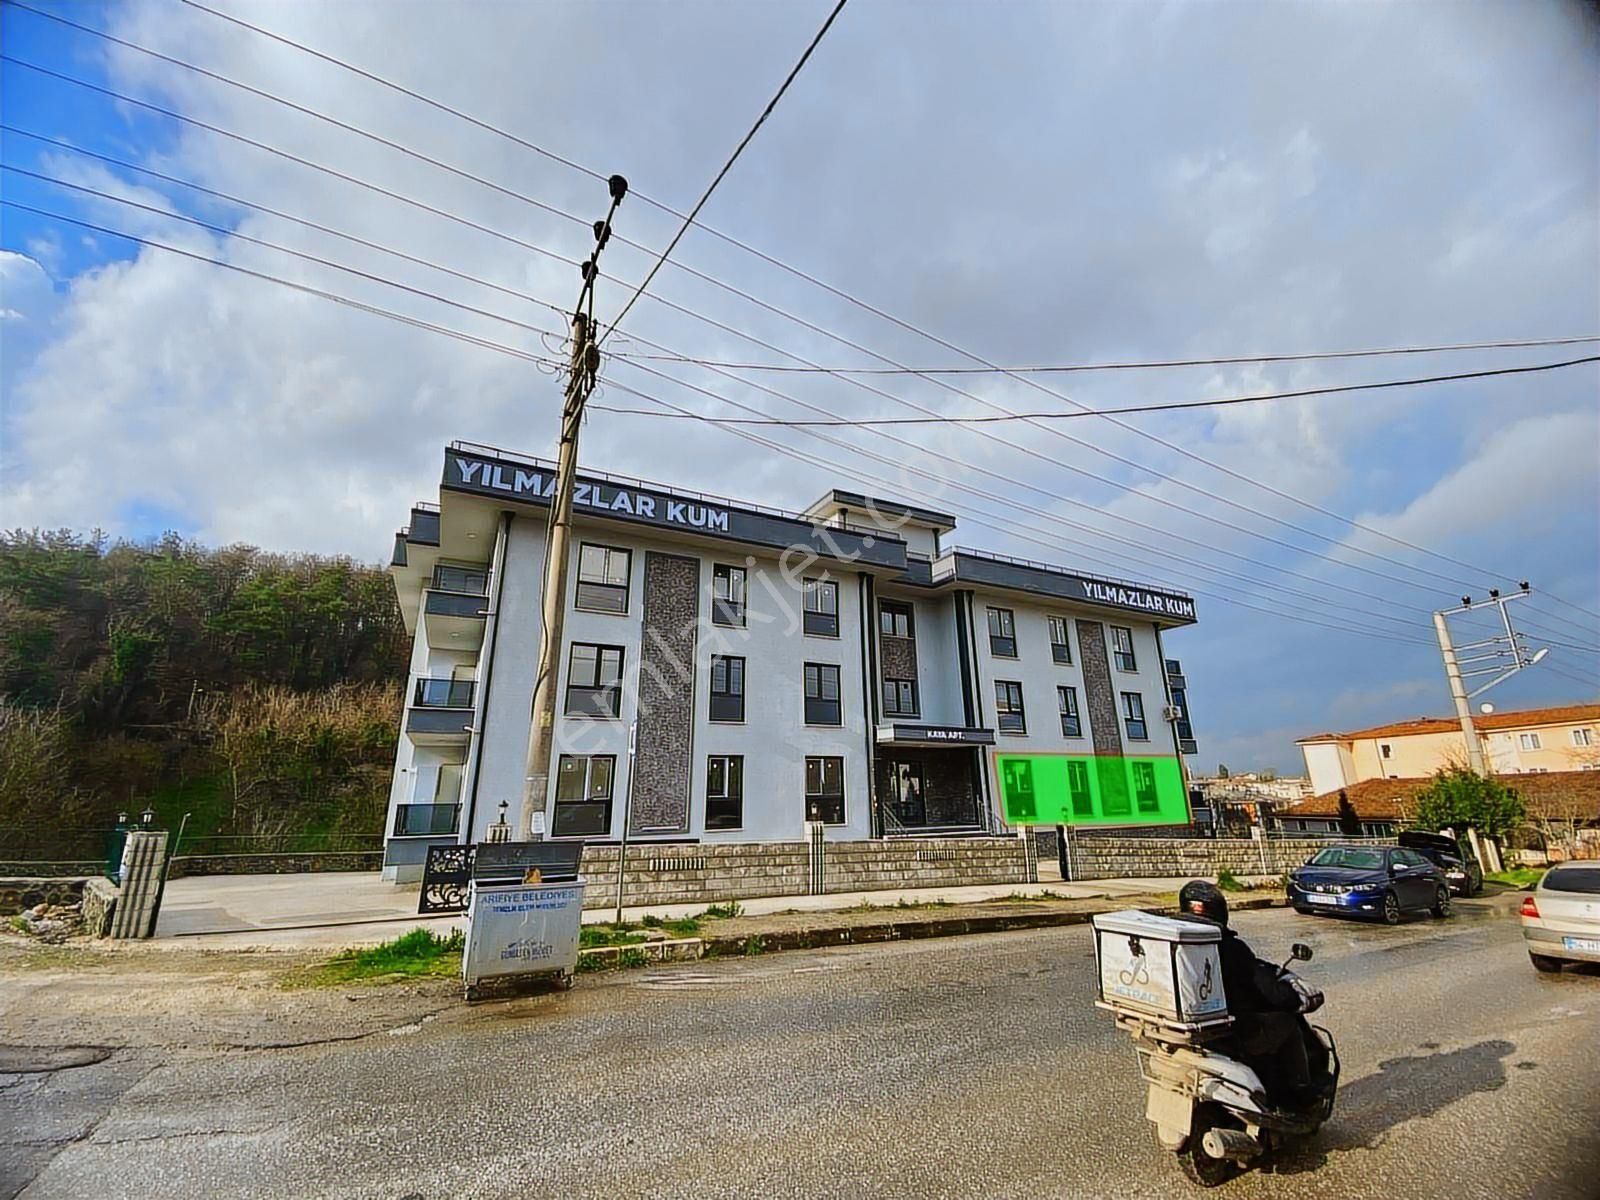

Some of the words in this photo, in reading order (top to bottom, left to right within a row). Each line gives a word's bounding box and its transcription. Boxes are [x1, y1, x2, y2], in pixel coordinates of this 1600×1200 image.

[667, 501, 729, 531] KUM
[1082, 581, 1164, 611] YILMAZLAR
[1165, 597, 1193, 616] KUM
